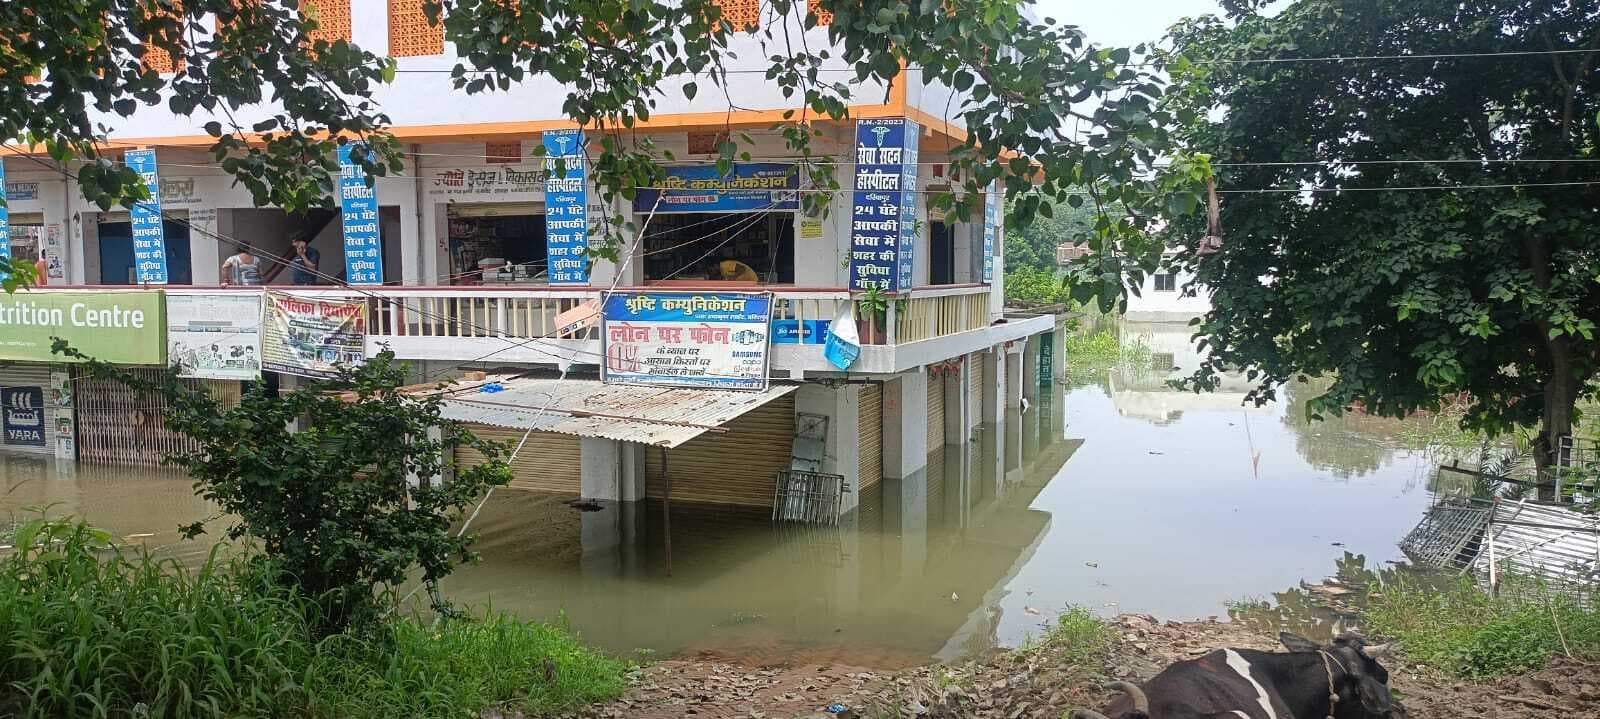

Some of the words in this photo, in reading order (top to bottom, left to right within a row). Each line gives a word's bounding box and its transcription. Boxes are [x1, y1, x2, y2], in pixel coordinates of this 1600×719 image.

[857, 142, 877, 165] सेवा
[879, 147, 902, 165] सदन
[856, 168, 900, 190] हॉस्पीटल
[344, 212, 358, 221] 24
[362, 210, 376, 220] घंटे
[547, 207, 564, 216] 24
[567, 204, 584, 215] घंटे
[855, 205, 874, 215] 24
[878, 203, 899, 216] घंटे
[344, 223, 376, 233] आपकी
[547, 218, 585, 230] आपकी
[853, 219, 899, 231] आपकी
[346, 236, 365, 246] सेवा
[367, 235, 377, 245] में
[548, 232, 570, 243] सेवा
[574, 232, 585, 242] में
[853, 234, 880, 246] सेवा
[882, 234, 897, 247] में
[548, 247, 569, 256] शहर
[570, 245, 585, 256] की
[852, 251, 876, 260] शहर
[878, 249, 896, 261] की
[552, 258, 581, 270] सुविधा
[574, 270, 584, 281] में
[855, 263, 891, 278] सुविधा
[879, 278, 892, 290] में
[70, 302, 145, 328] Centre
[608, 321, 651, 344] लोन
[656, 325, 684, 344] पर
[688, 322, 731, 344] फोन
[688, 347, 701, 356] पर
[732, 350, 762, 358] SAMSUNG
[8, 429, 41, 441] YARA
